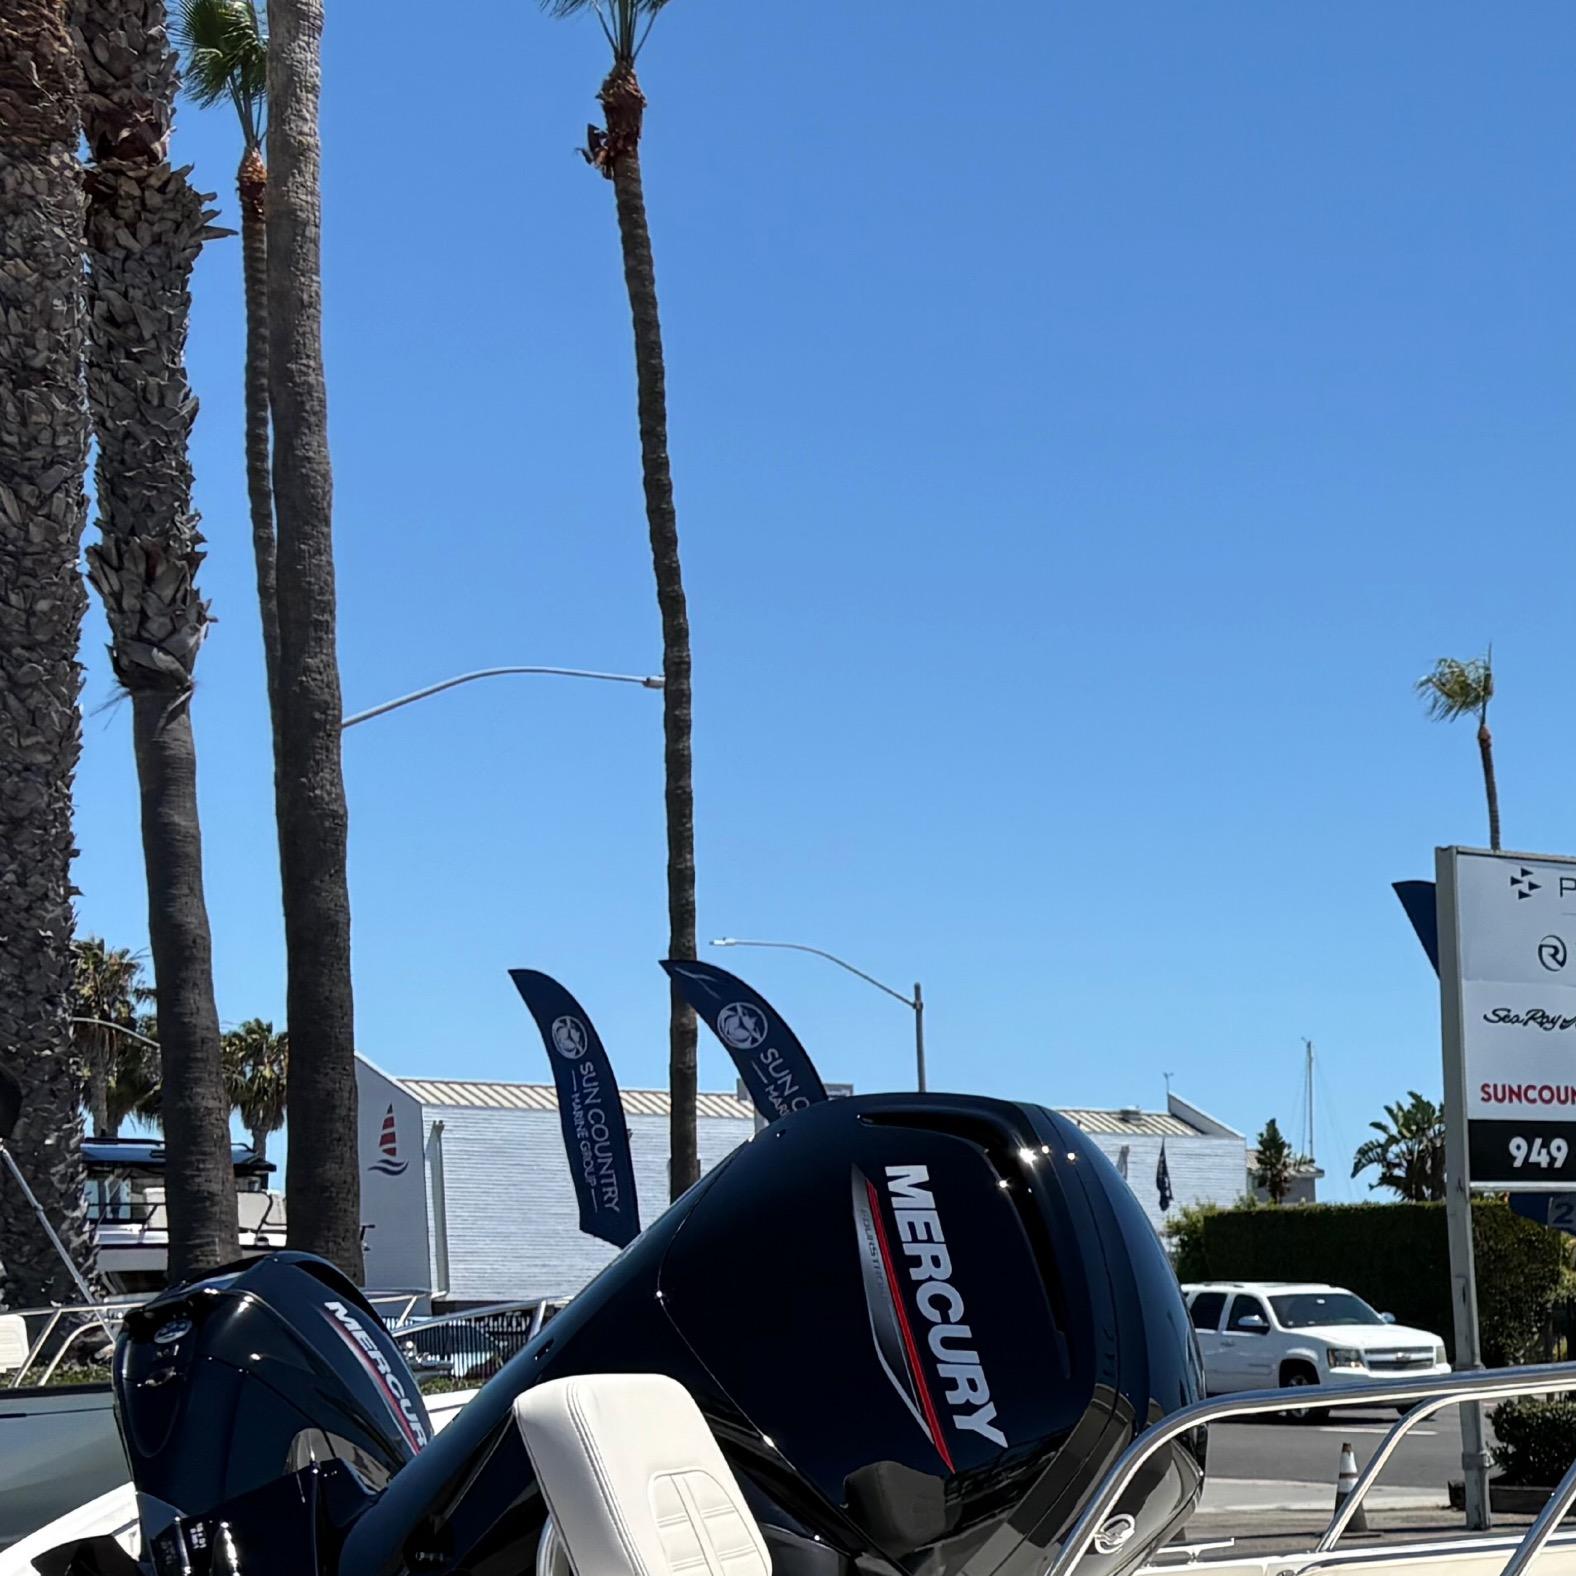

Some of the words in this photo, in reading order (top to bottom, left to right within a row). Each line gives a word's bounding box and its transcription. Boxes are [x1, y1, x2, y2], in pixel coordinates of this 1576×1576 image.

[579, 1060, 602, 1105] SUN
[759, 1048, 800, 1097] SUN
[571, 1091, 589, 1140] MARINE
[579, 1139, 598, 1188] GROUP
[587, 1108, 621, 1213] COUNTRY
[1508, 1136, 1569, 1169] 949
[884, 1164, 1009, 1449] MERCURY
[324, 1301, 428, 1447] MERCUR
